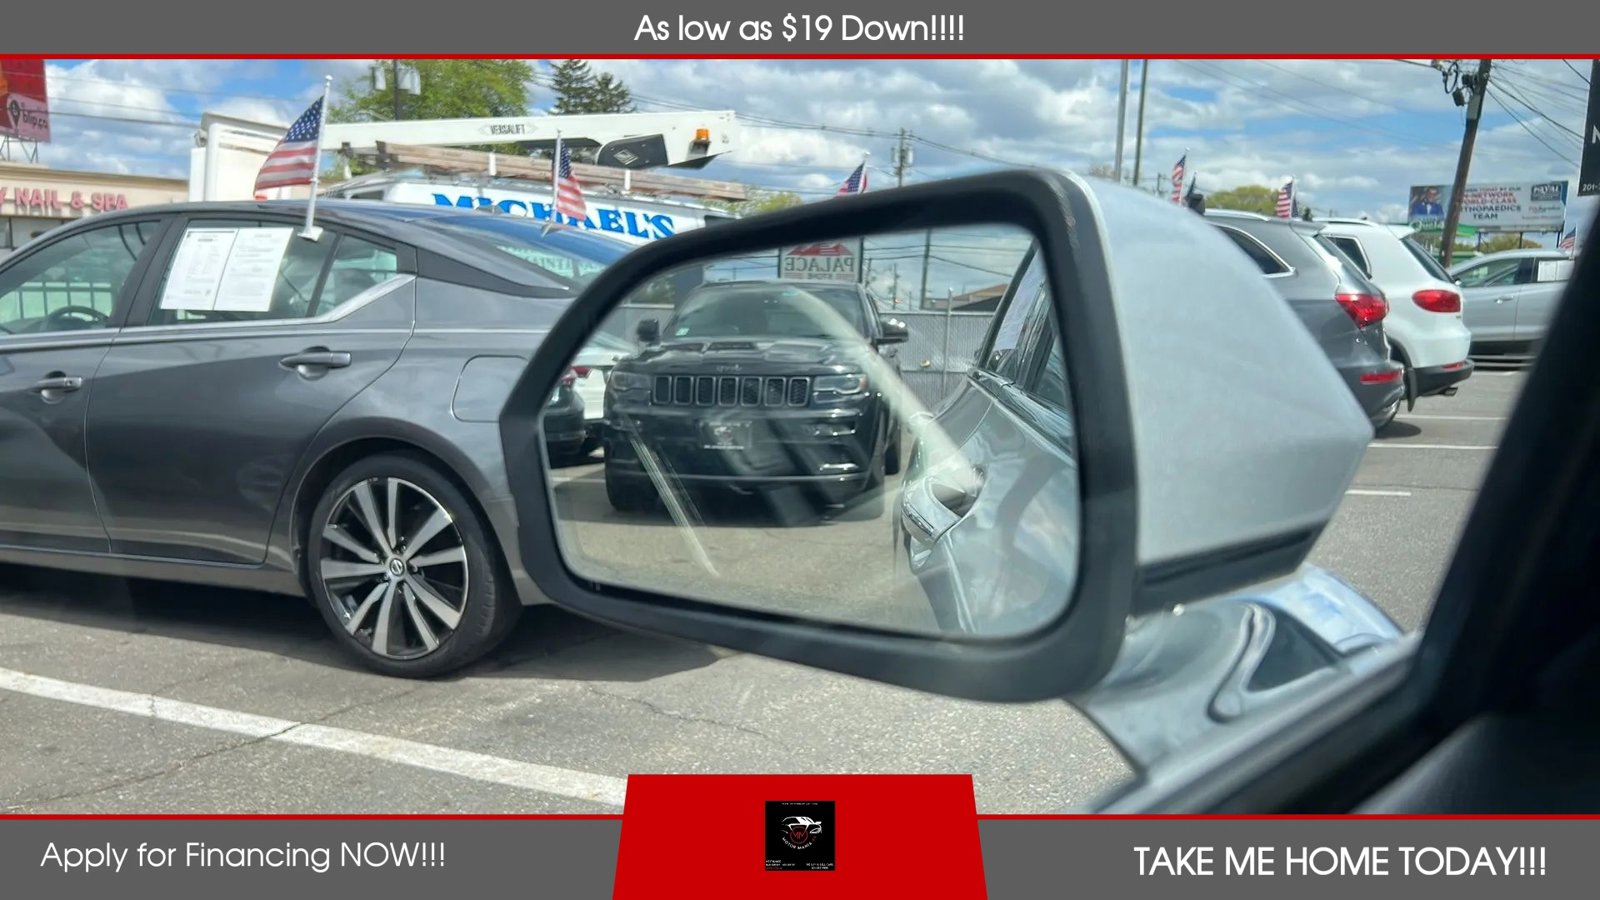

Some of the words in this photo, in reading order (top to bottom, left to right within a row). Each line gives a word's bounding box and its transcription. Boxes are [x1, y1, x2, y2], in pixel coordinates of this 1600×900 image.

[490, 123, 525, 135] VERSALIFT
[1582, 182, 1600, 191] 201-
[14, 187, 62, 210] NAIL
[71, 190, 86, 209] &
[91, 192, 129, 210] SPA
